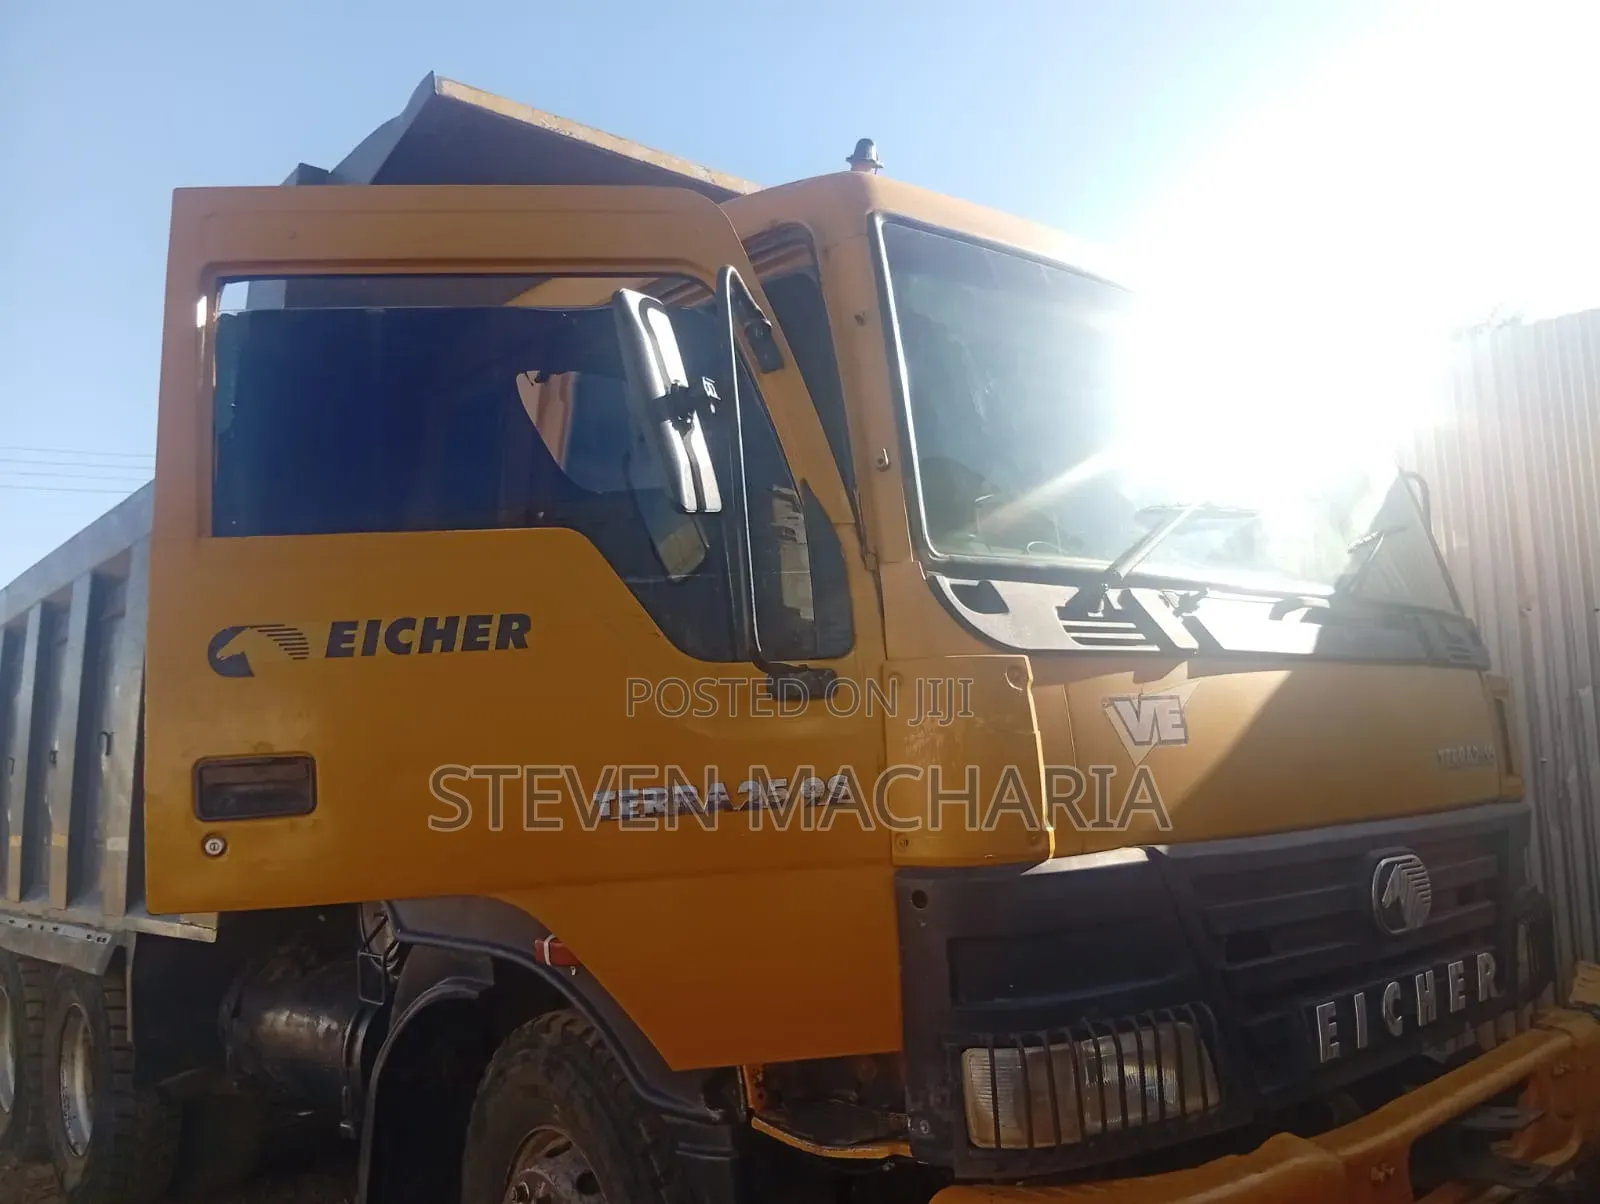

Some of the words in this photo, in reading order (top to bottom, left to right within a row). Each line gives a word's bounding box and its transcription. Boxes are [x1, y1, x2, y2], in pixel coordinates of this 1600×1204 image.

[324, 613, 531, 658] EICHER
[593, 781, 734, 821] TERRA
[1316, 952, 1504, 1064] EICHER
